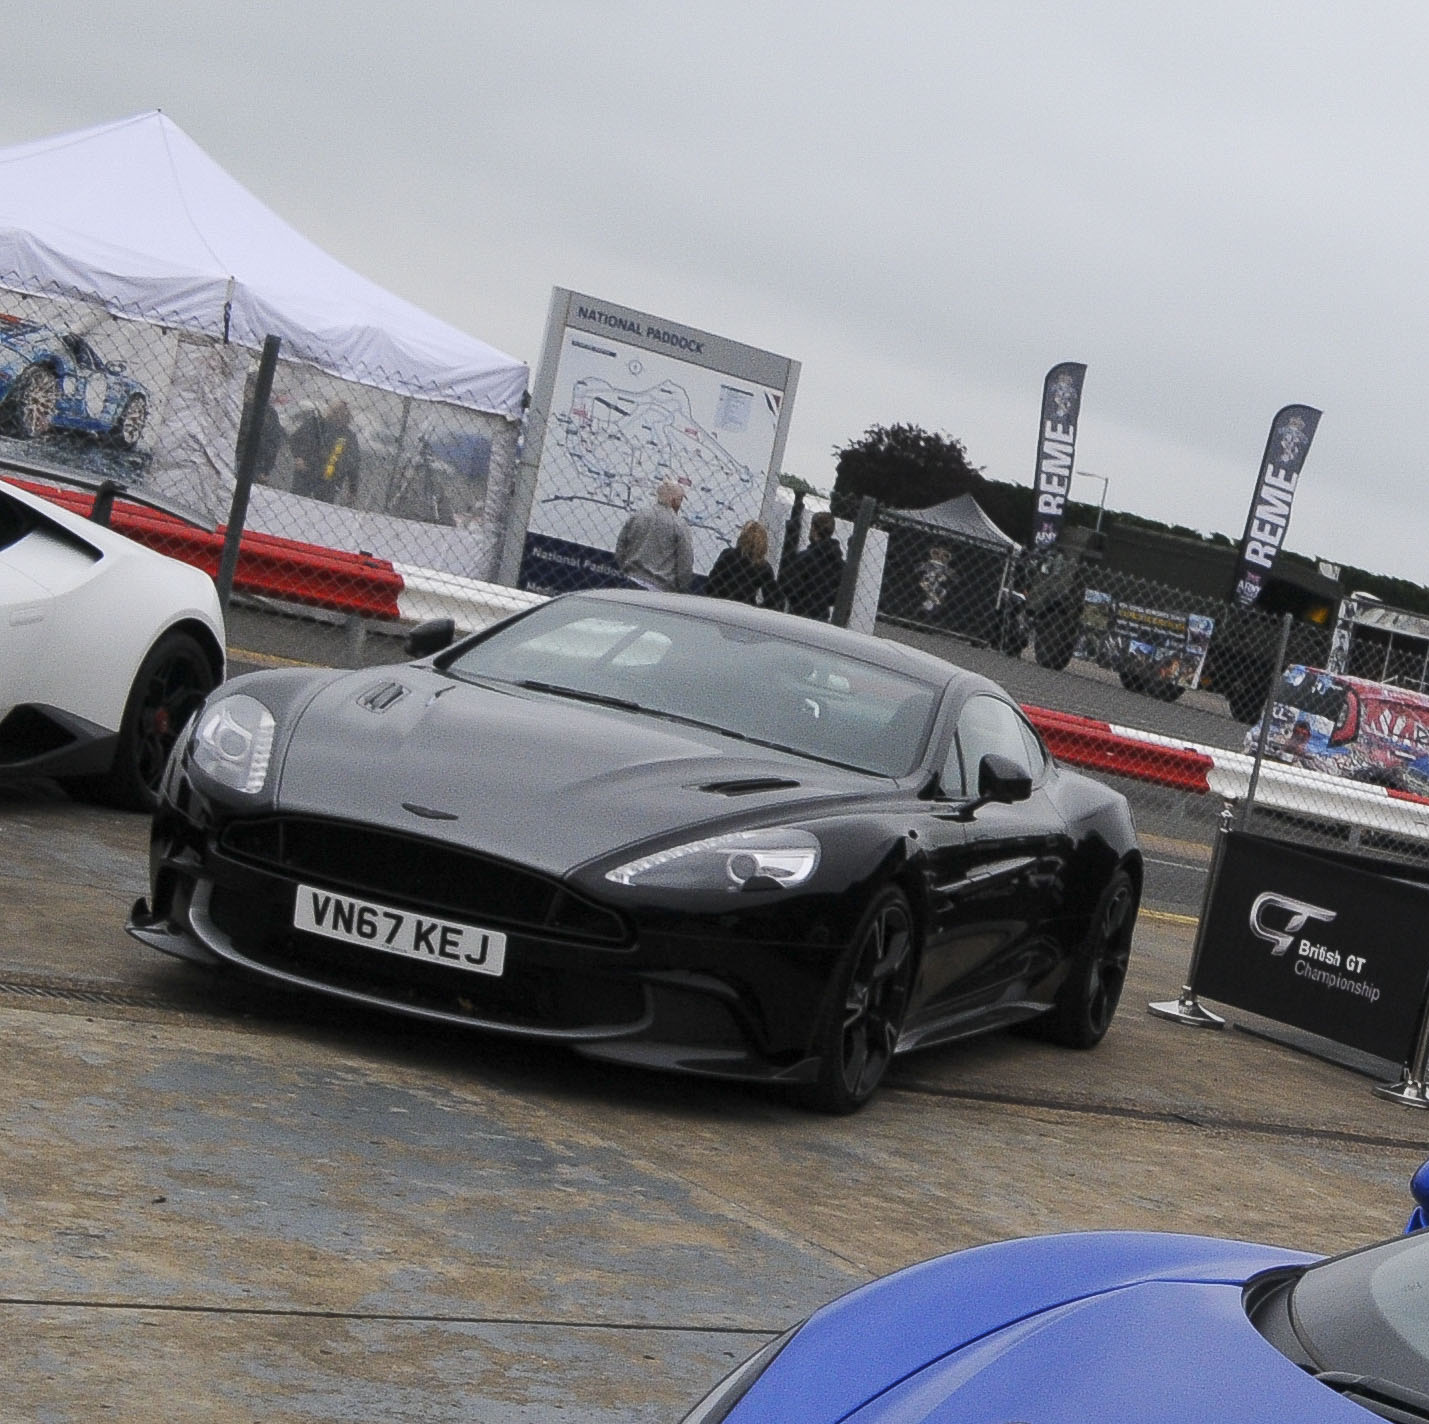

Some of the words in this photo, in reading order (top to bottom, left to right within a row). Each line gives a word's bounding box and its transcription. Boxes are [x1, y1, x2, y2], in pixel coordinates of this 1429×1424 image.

[578, 306, 642, 336] NATIONAL
[646, 326, 705, 355] PADDOCK
[1038, 420, 1074, 516] REME
[1244, 463, 1298, 569] REME
[583, 559, 621, 578] Paddoc
[312, 891, 404, 945] VN67
[413, 919, 490, 966] KEJ
[1299, 939, 1341, 967] British
[1346, 955, 1367, 974] GT
[1294, 960, 1381, 1003] Championship
